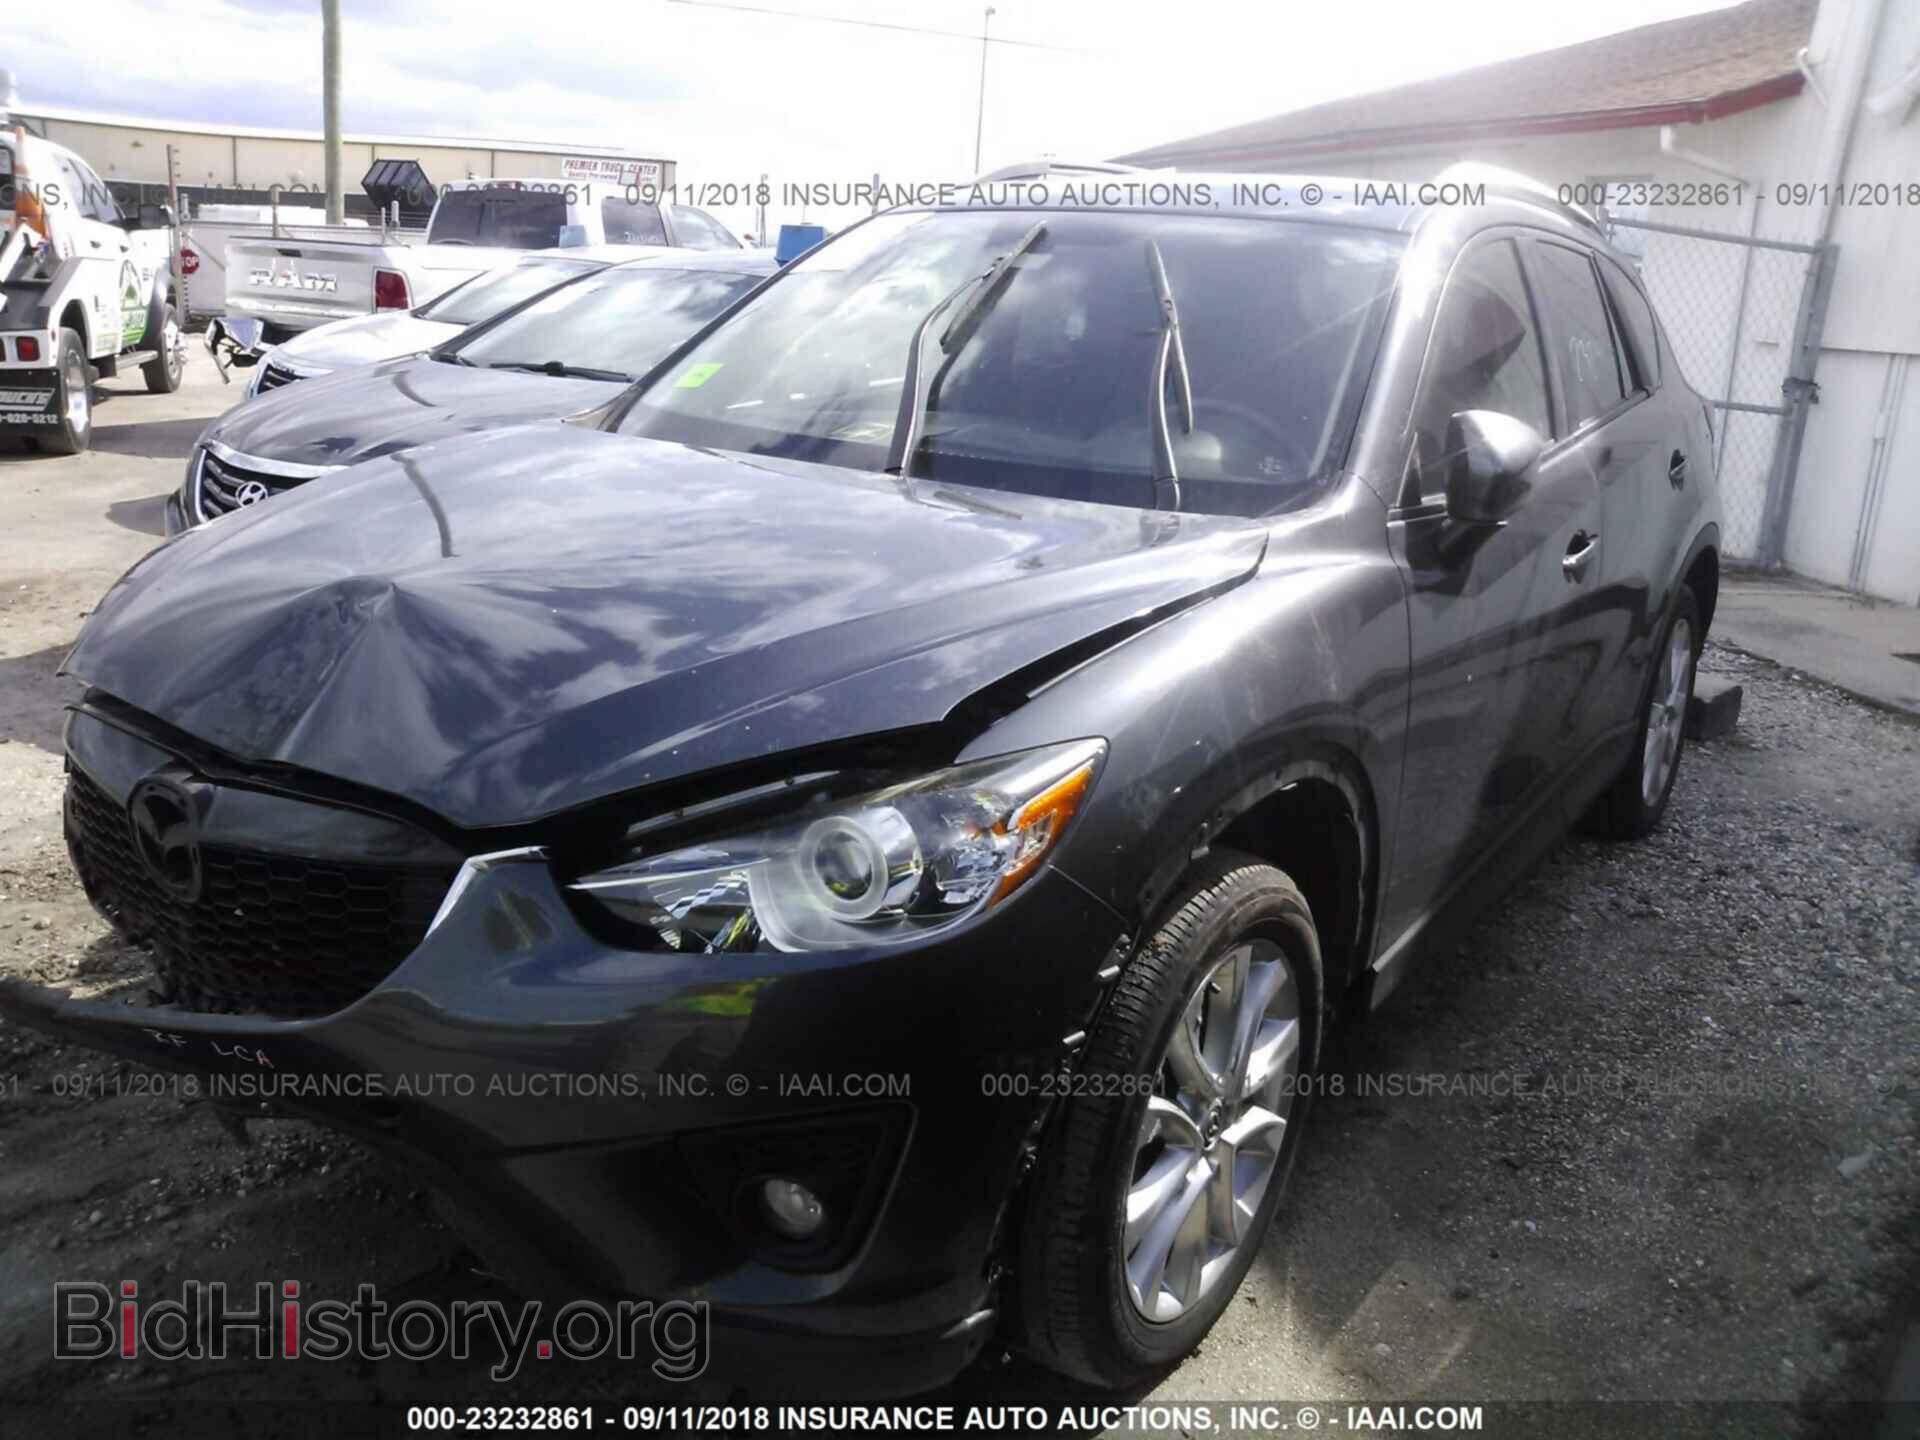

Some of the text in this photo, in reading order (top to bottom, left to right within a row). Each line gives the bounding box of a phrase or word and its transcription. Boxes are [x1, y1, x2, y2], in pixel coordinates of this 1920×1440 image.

[564, 160, 599, 171] PREMIER
[628, 164, 657, 175] CENTER
[250, 268, 337, 292] RAM
